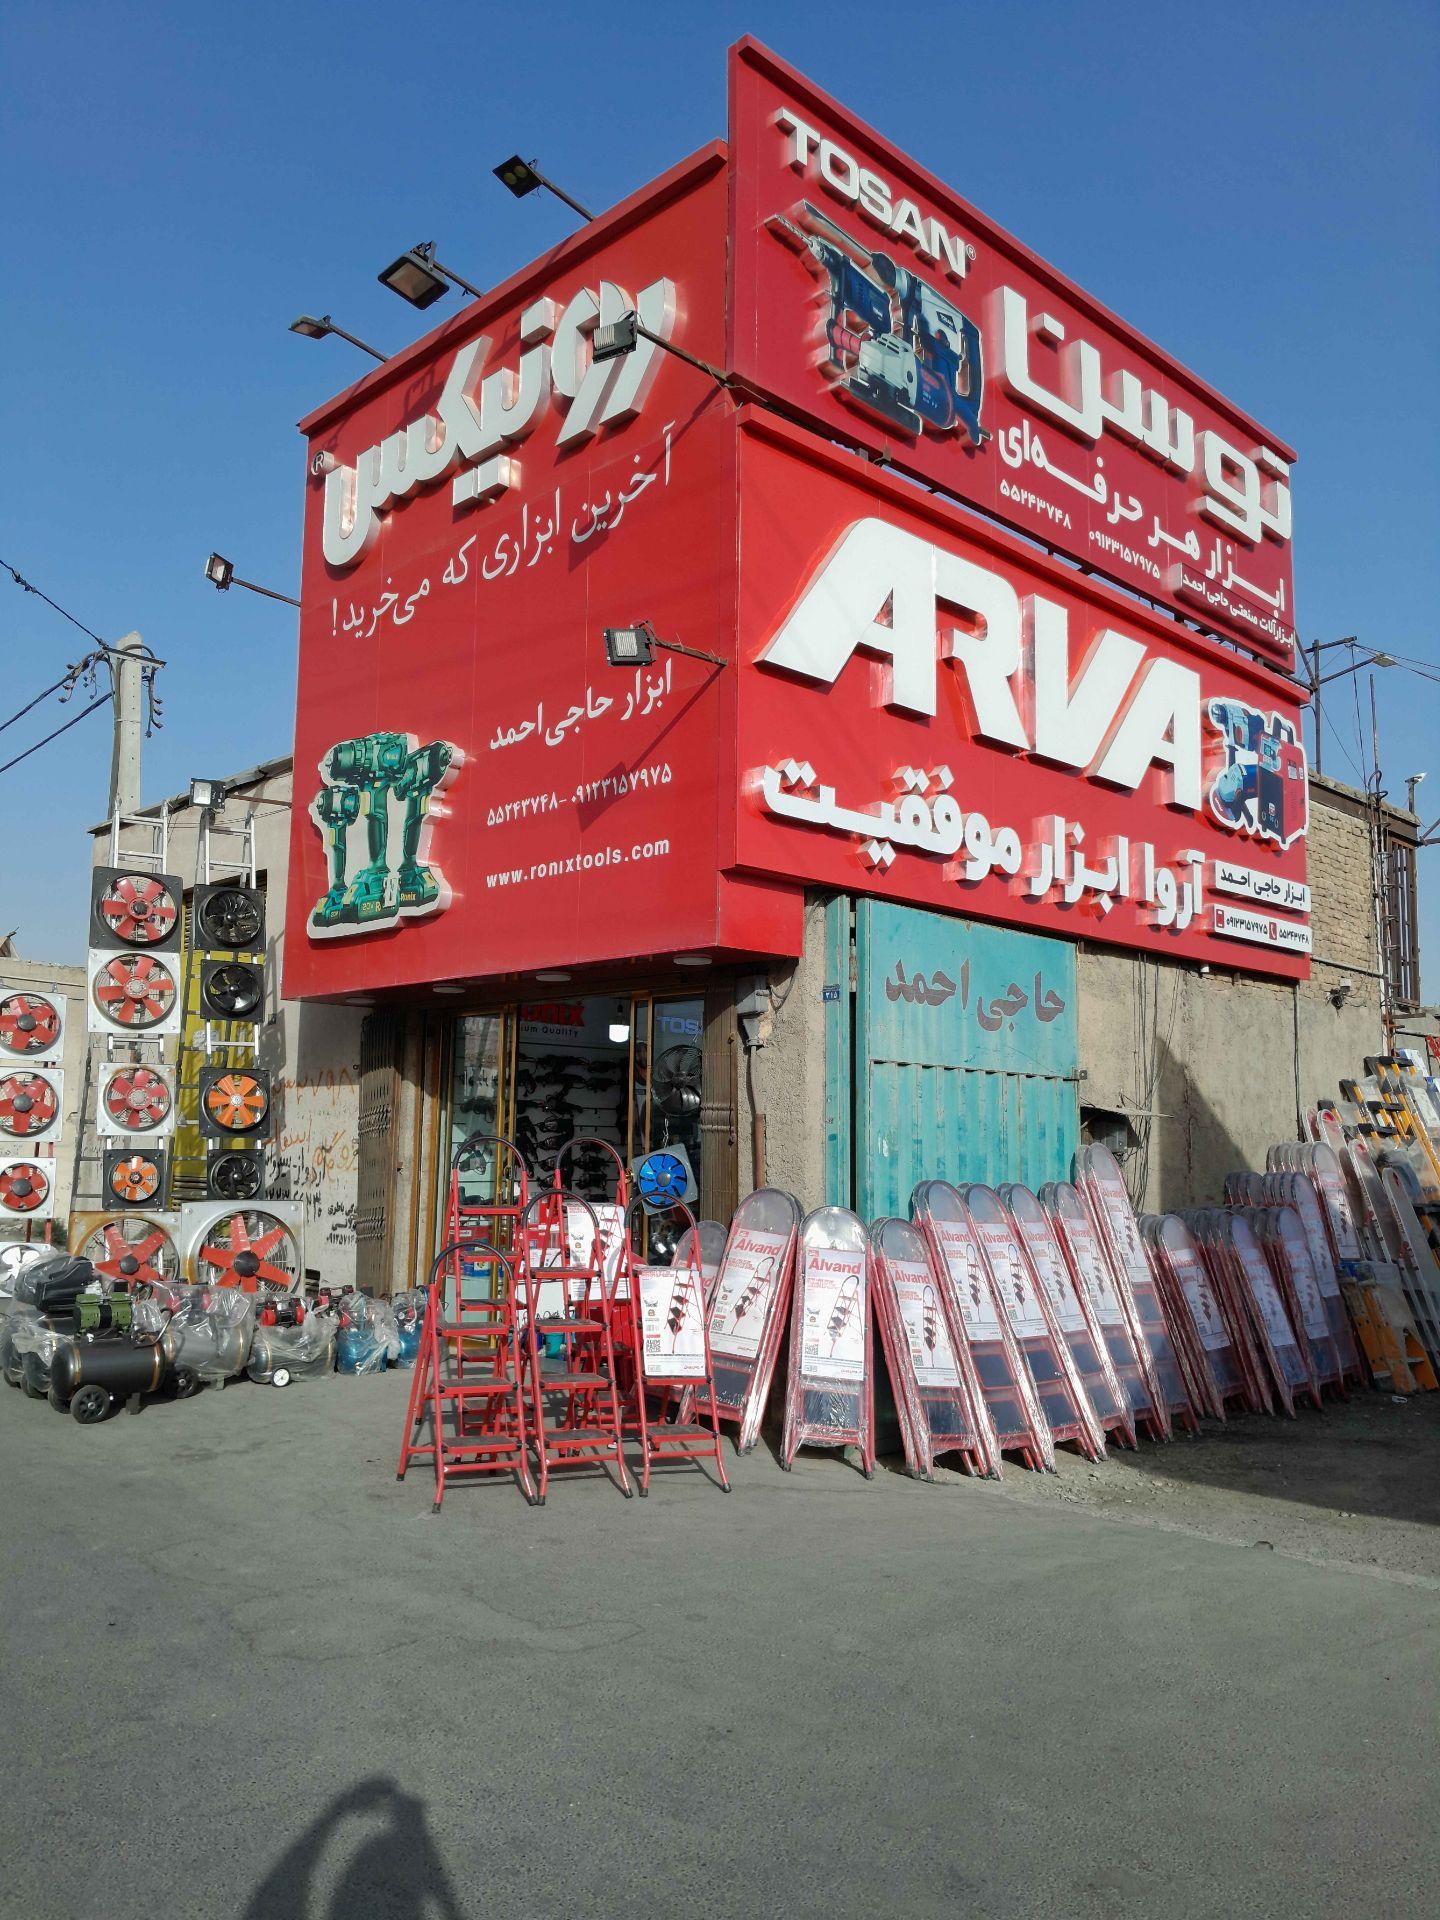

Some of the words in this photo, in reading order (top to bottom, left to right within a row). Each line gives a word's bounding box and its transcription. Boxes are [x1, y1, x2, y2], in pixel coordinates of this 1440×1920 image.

[779, 107, 967, 280] TOSAN
[323, 277, 677, 567] رونیکس
[999, 286, 1292, 544] توسن
[571, 420, 676, 543] آخرین
[1000, 479, 1072, 530] ۵۵۲۴۳۷۴۸
[482, 487, 560, 580] ابزاری
[1088, 531, 1161, 579] ۰۹۱۲۳۱۵۷۹۷۵
[1147, 515, 1200, 561] هر
[442, 534, 477, 585] که
[1183, 573, 1206, 595] احمد
[1205, 535, 1285, 618] ابزار
[1206, 591, 1229, 606] حاجی
[620, 658, 672, 720] ابزار
[754, 517, 1201, 812] ARVA
[490, 701, 544, 750] احمد
[544, 686, 614, 747] حاجی
[761, 757, 1022, 881] موفقیت
[486, 838, 671, 888] www.ronixtools.com
[1029, 814, 1129, 915] ابزار
[1144, 842, 1206, 929] آروا
[1220, 868, 1250, 888] احمد
[1253, 878, 1281, 897] حاجی
[1283, 883, 1305, 906] ابزار
[885, 957, 970, 1007] احمد
[976, 969, 1066, 1032] حاجی
[734, 1237, 783, 1257] Alvand
[808, 1257, 862, 1276] Alvand
[894, 1269, 931, 1285] Alvand
